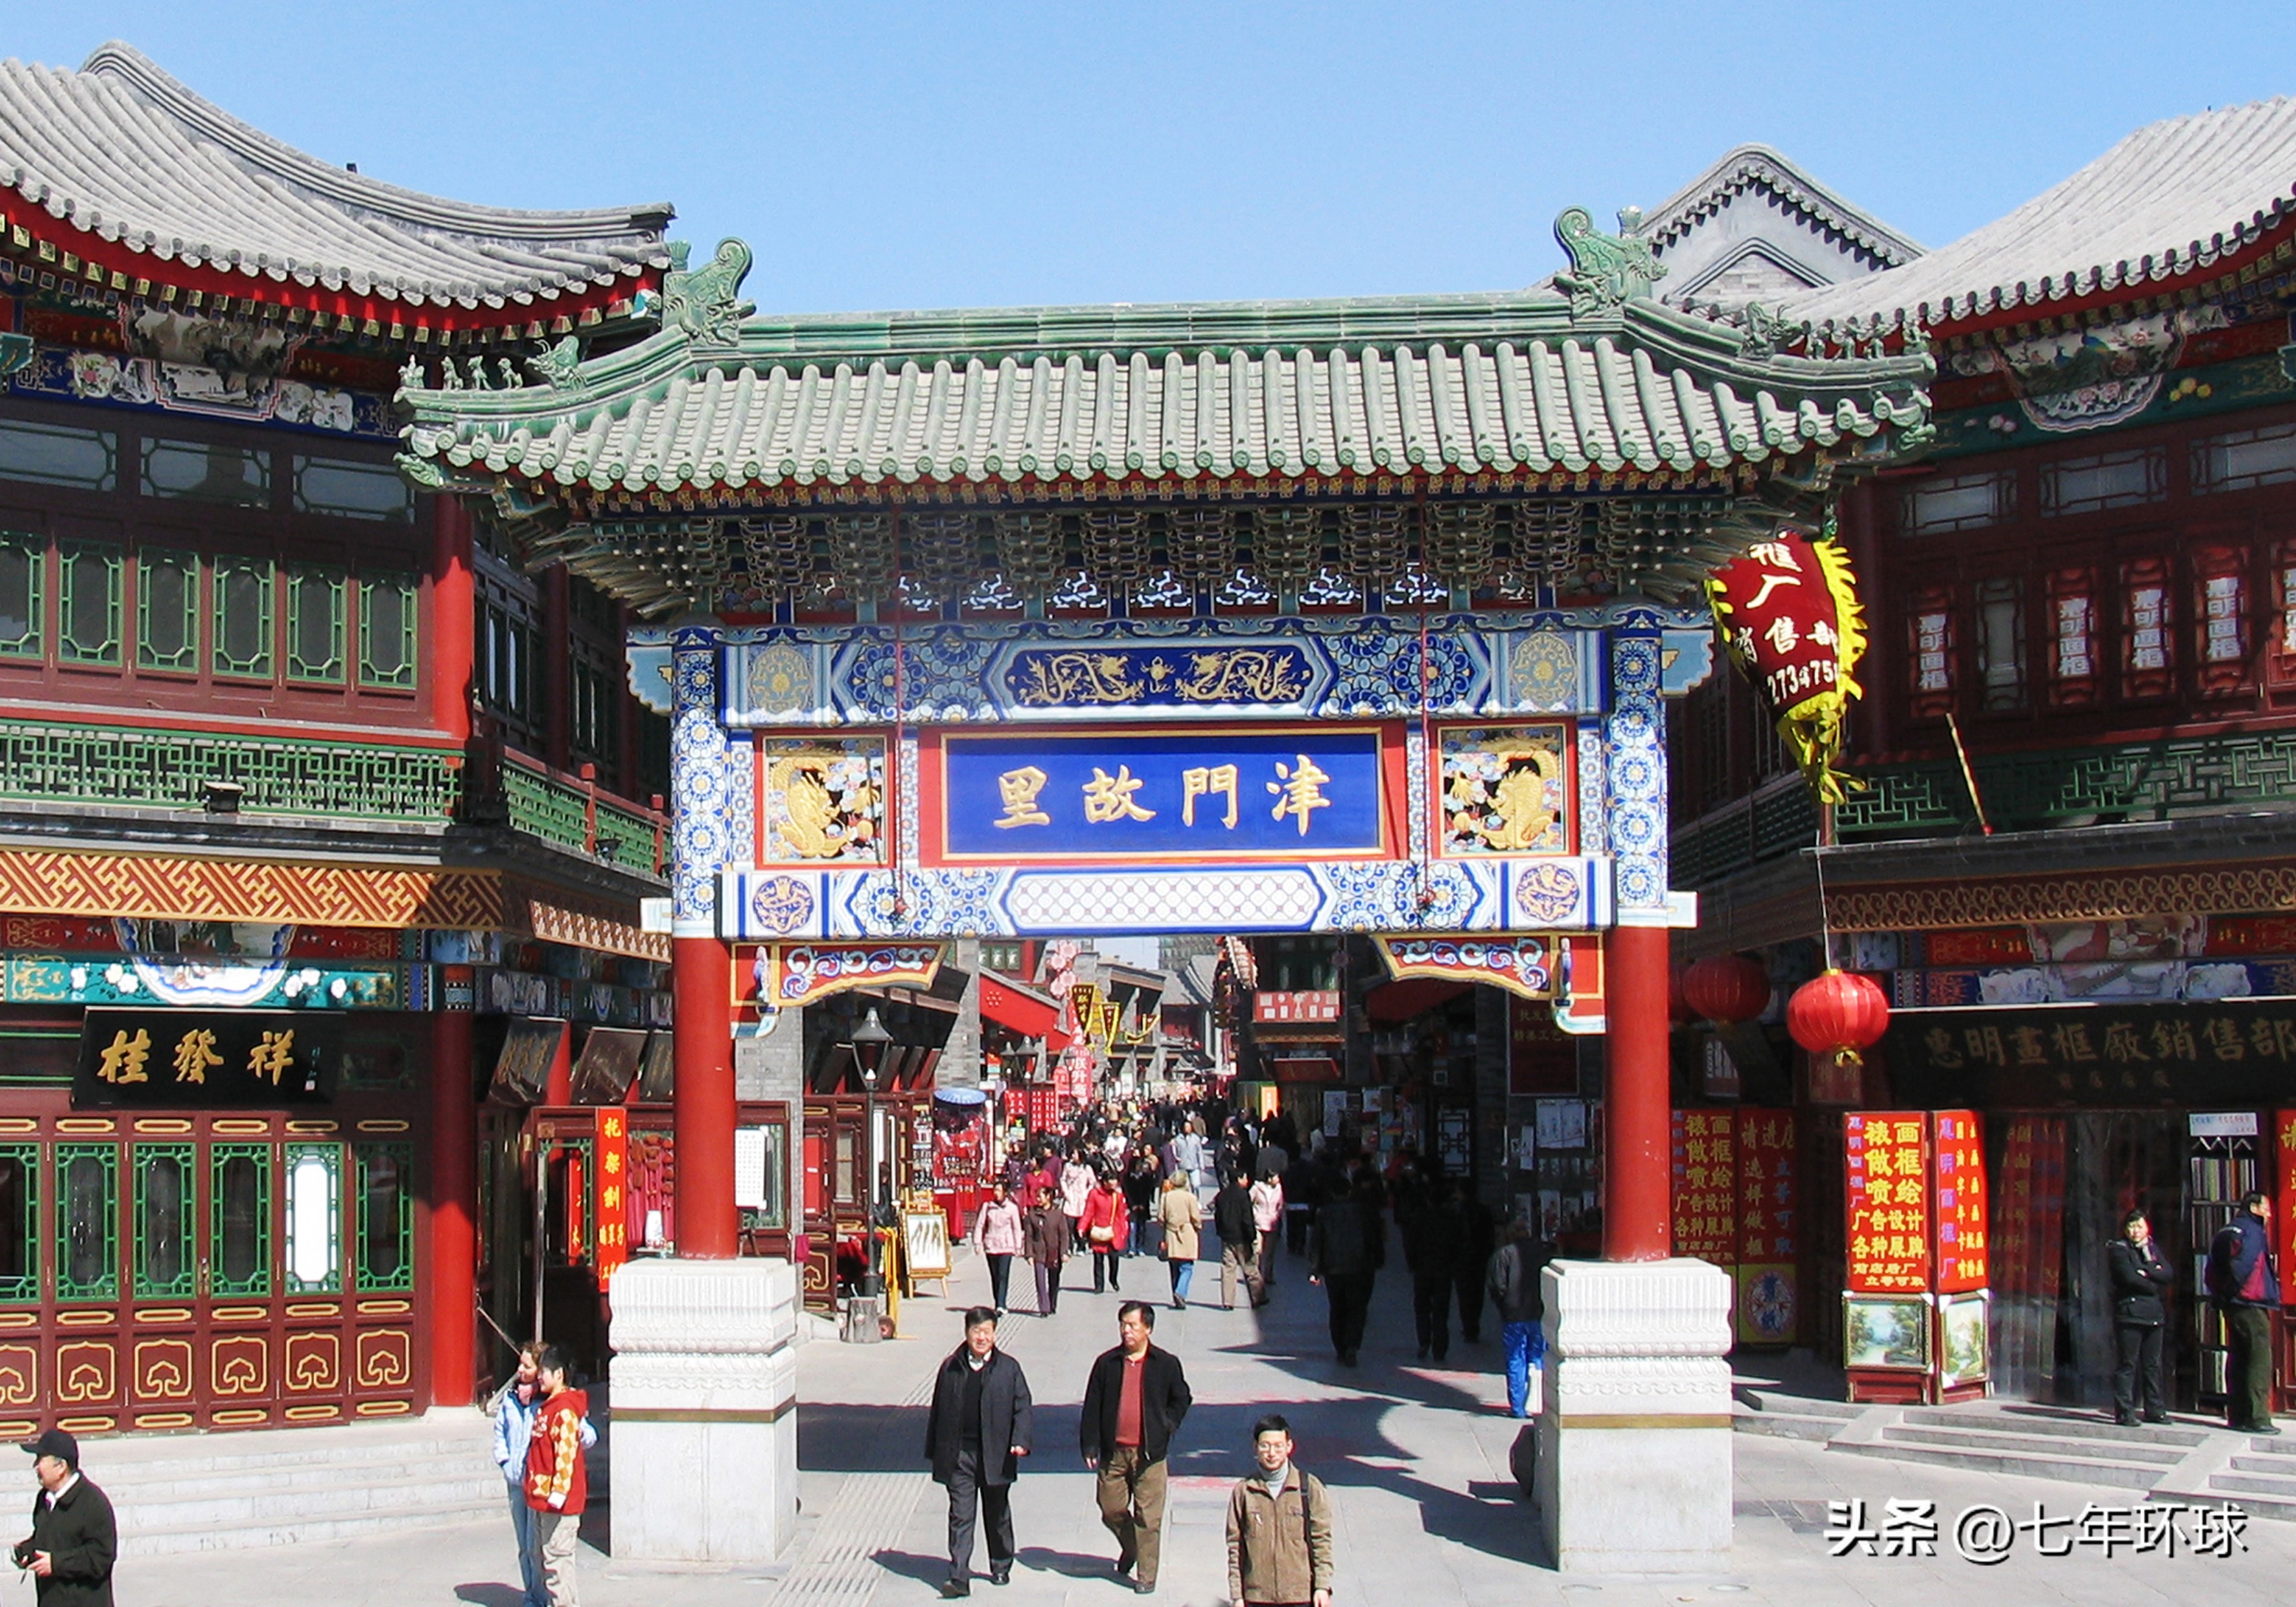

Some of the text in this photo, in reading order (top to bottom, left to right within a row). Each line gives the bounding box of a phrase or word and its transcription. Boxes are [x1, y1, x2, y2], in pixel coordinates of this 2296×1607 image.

[97, 1028, 296, 1086] 桂發祥
[1863, 1147, 1923, 1177] 做框
[1864, 1177, 1923, 1206] 喷绘
[1851, 1208, 1925, 1232] 广告设计
[1851, 1234, 1925, 1260] 各种展牌
